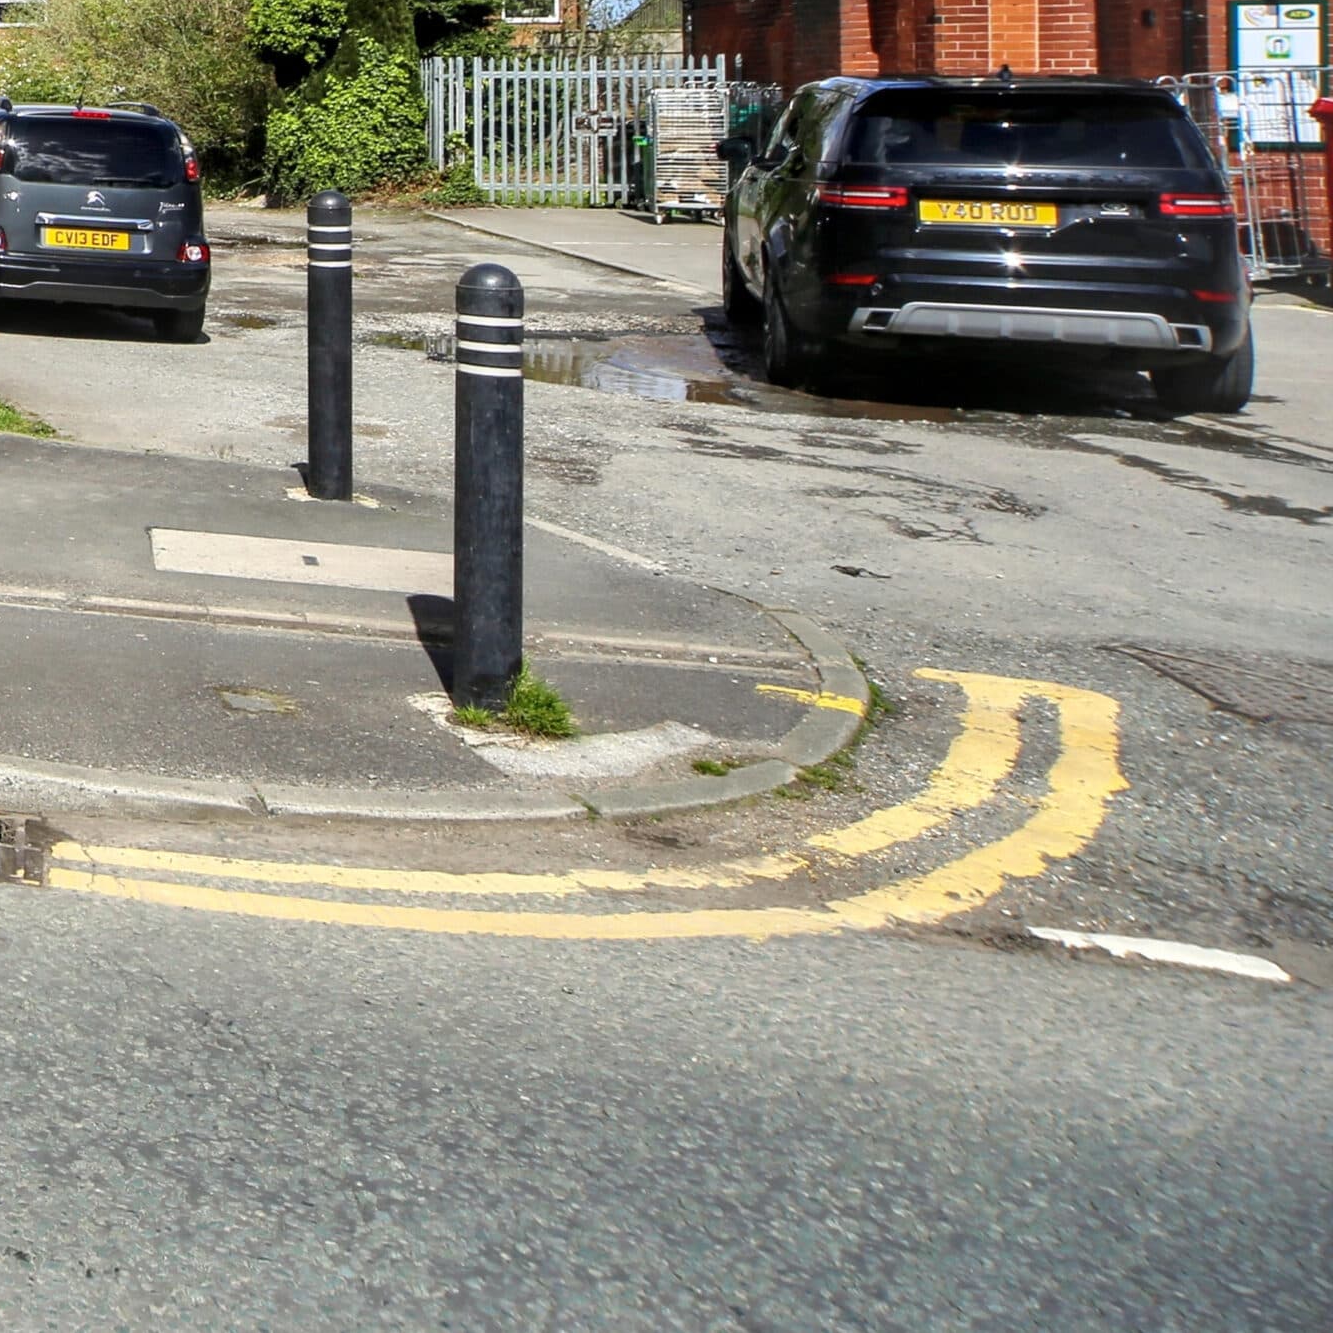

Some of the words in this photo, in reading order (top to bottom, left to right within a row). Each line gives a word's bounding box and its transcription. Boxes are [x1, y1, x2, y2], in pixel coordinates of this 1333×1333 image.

[937, 202, 983, 219] Y40
[54, 231, 87, 245] CV13
[92, 233, 120, 247] EDF
